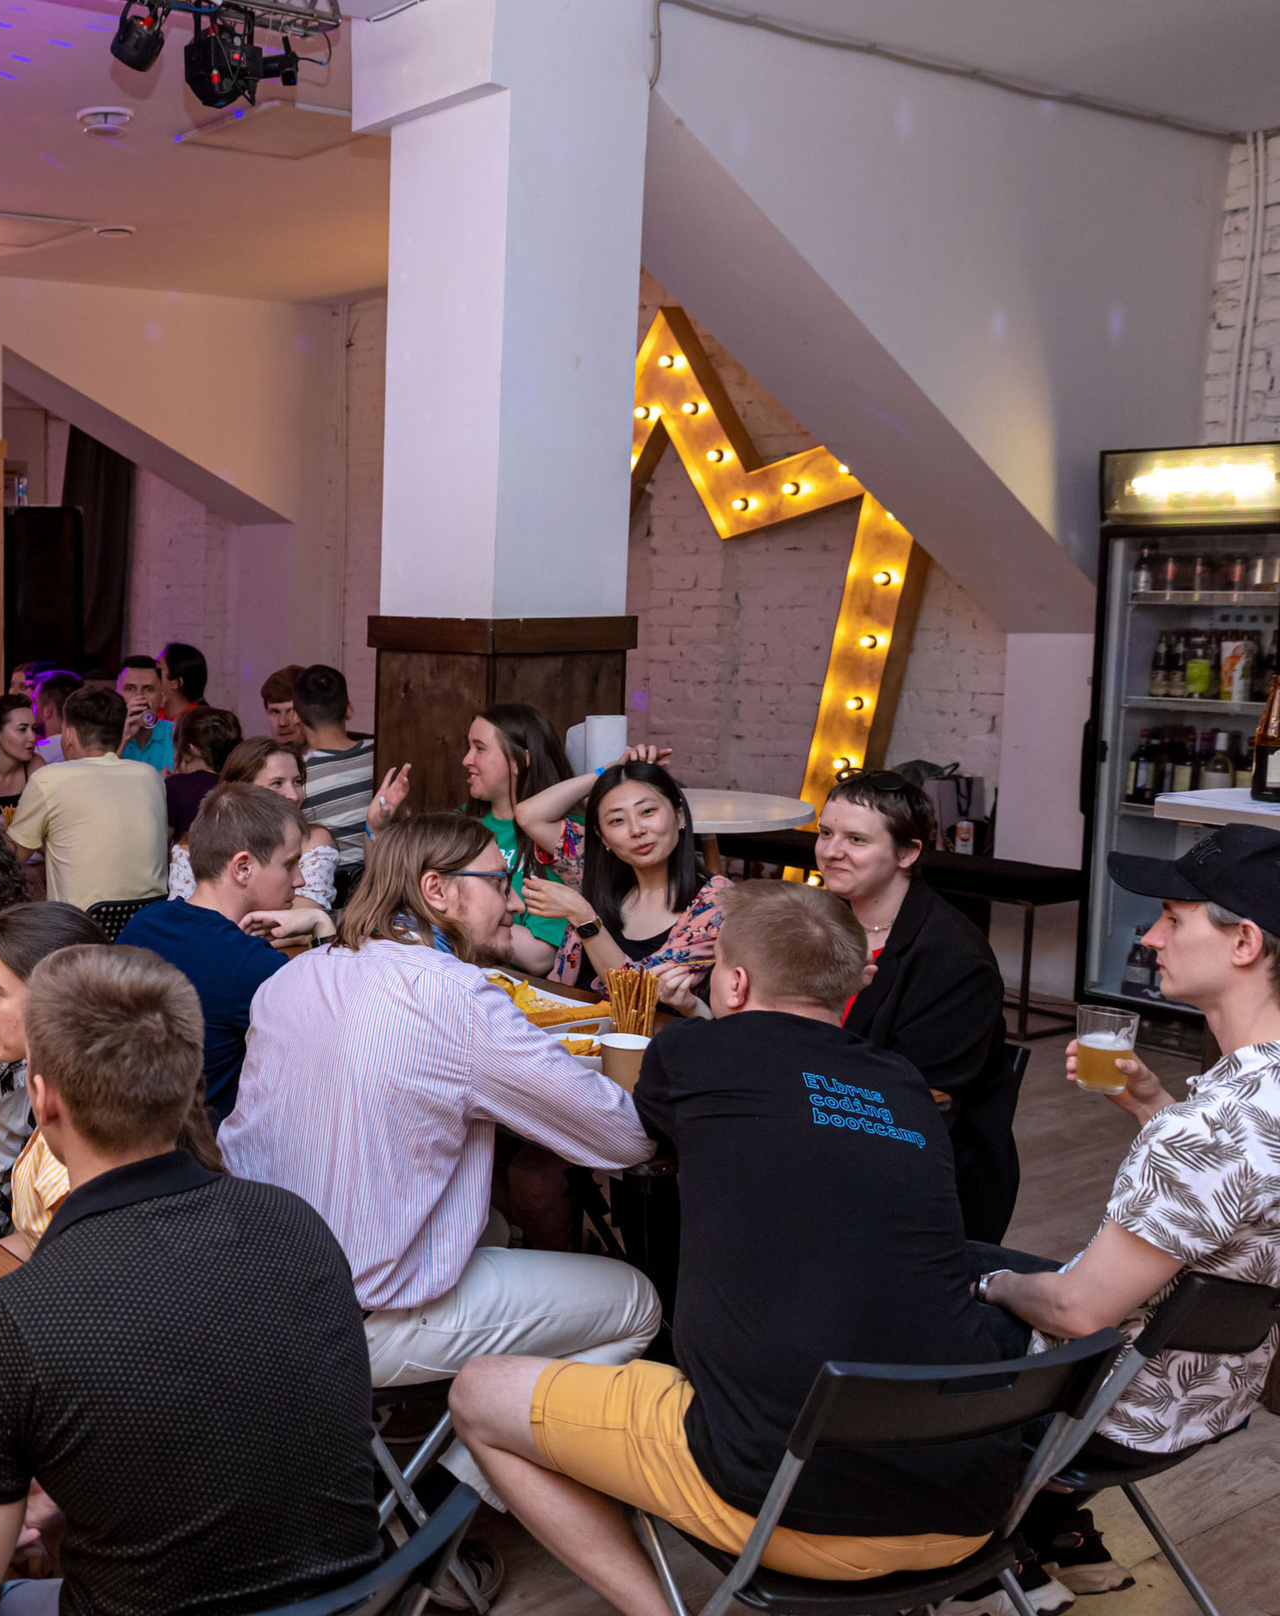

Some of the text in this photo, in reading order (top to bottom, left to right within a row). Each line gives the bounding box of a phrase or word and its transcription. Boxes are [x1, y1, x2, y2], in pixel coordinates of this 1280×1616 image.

[802, 1072, 885, 1104] Elbrus
[809, 1093, 894, 1124] coding
[812, 1107, 926, 1149] bootcamp
